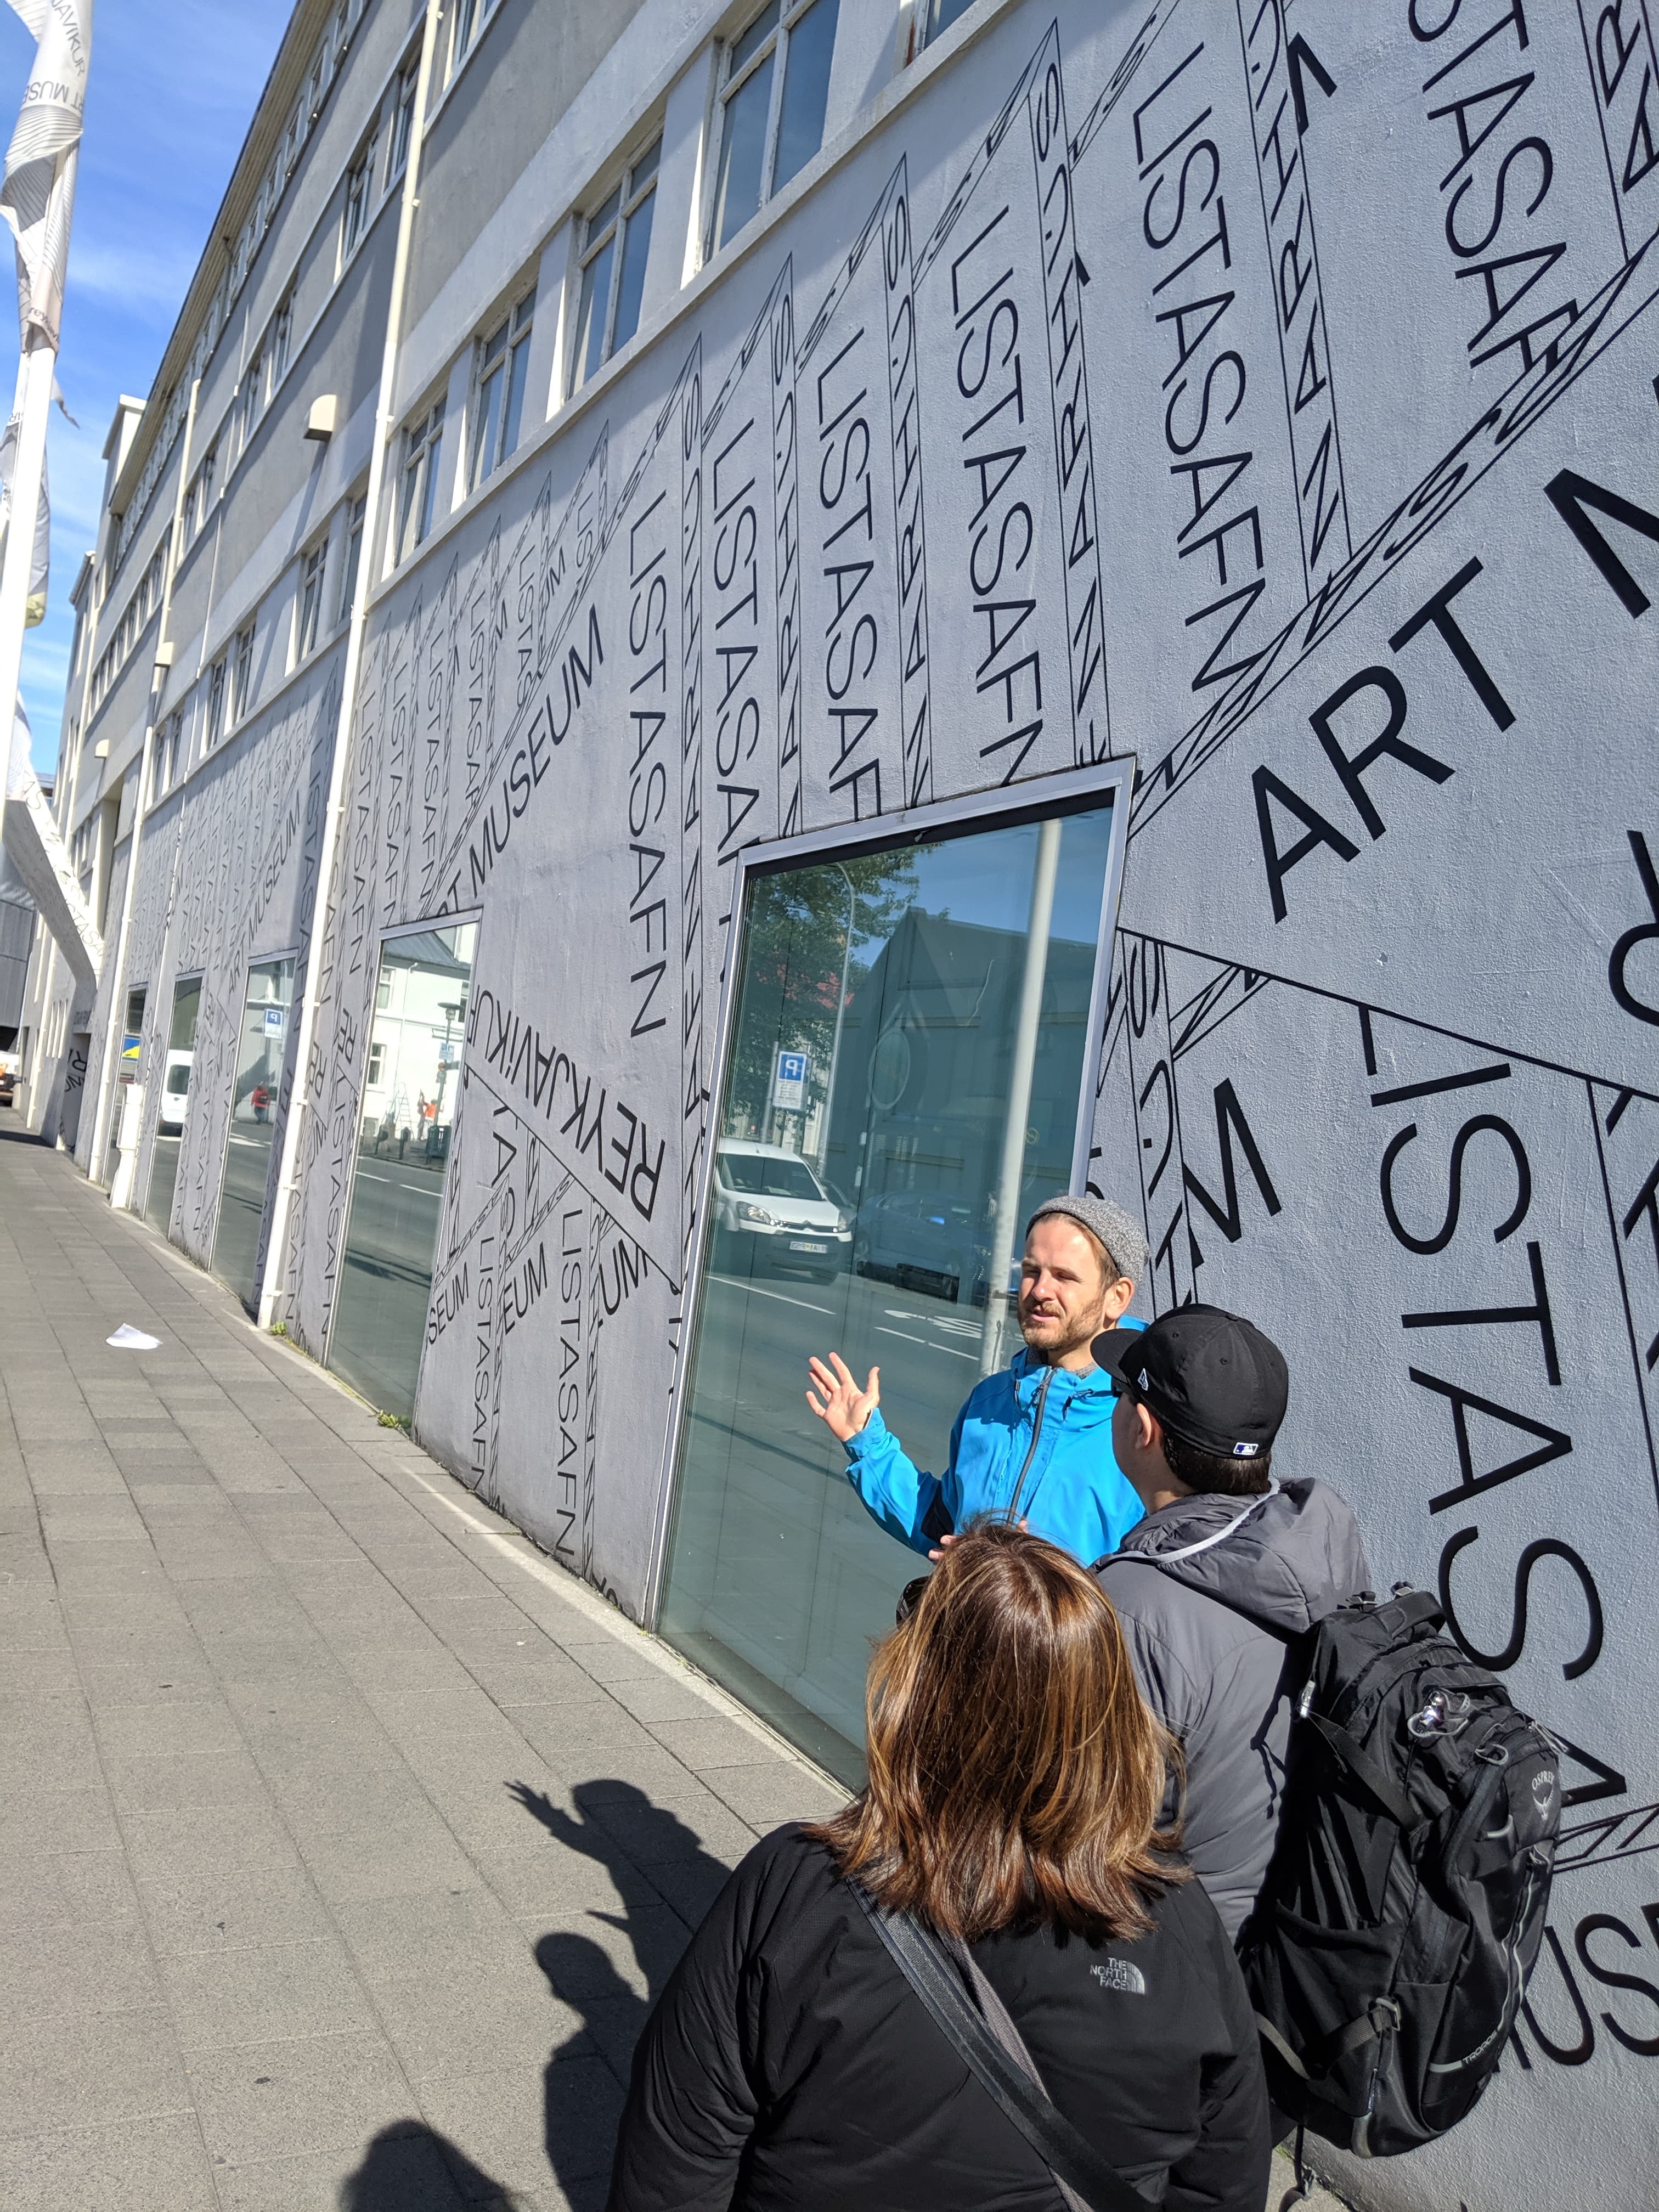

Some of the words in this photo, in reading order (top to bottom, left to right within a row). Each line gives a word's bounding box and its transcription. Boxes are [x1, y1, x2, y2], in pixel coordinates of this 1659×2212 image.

[1132, 41, 1267, 693] LISTASAFN
[249, 788, 300, 950] MUSEUM
[349, 689, 377, 975] LISTASAFN
[419, 628, 444, 900] LISTASAFN
[470, 602, 605, 900] MUSEUM
[629, 488, 667, 1039] LISTASAFN
[1252, 556, 1517, 925] ART
[470, 1235, 495, 1492] LISTASAFN
[555, 1209, 583, 1556] LISTASAFN
[1531, 1770, 1555, 1791] OSPREY
[1090, 1964, 1127, 1980] NORTH
[1099, 1977, 1128, 1990] FACE
[1107, 1957, 1127, 1969] THE
[1462, 2029, 1498, 2064] TROPOS
